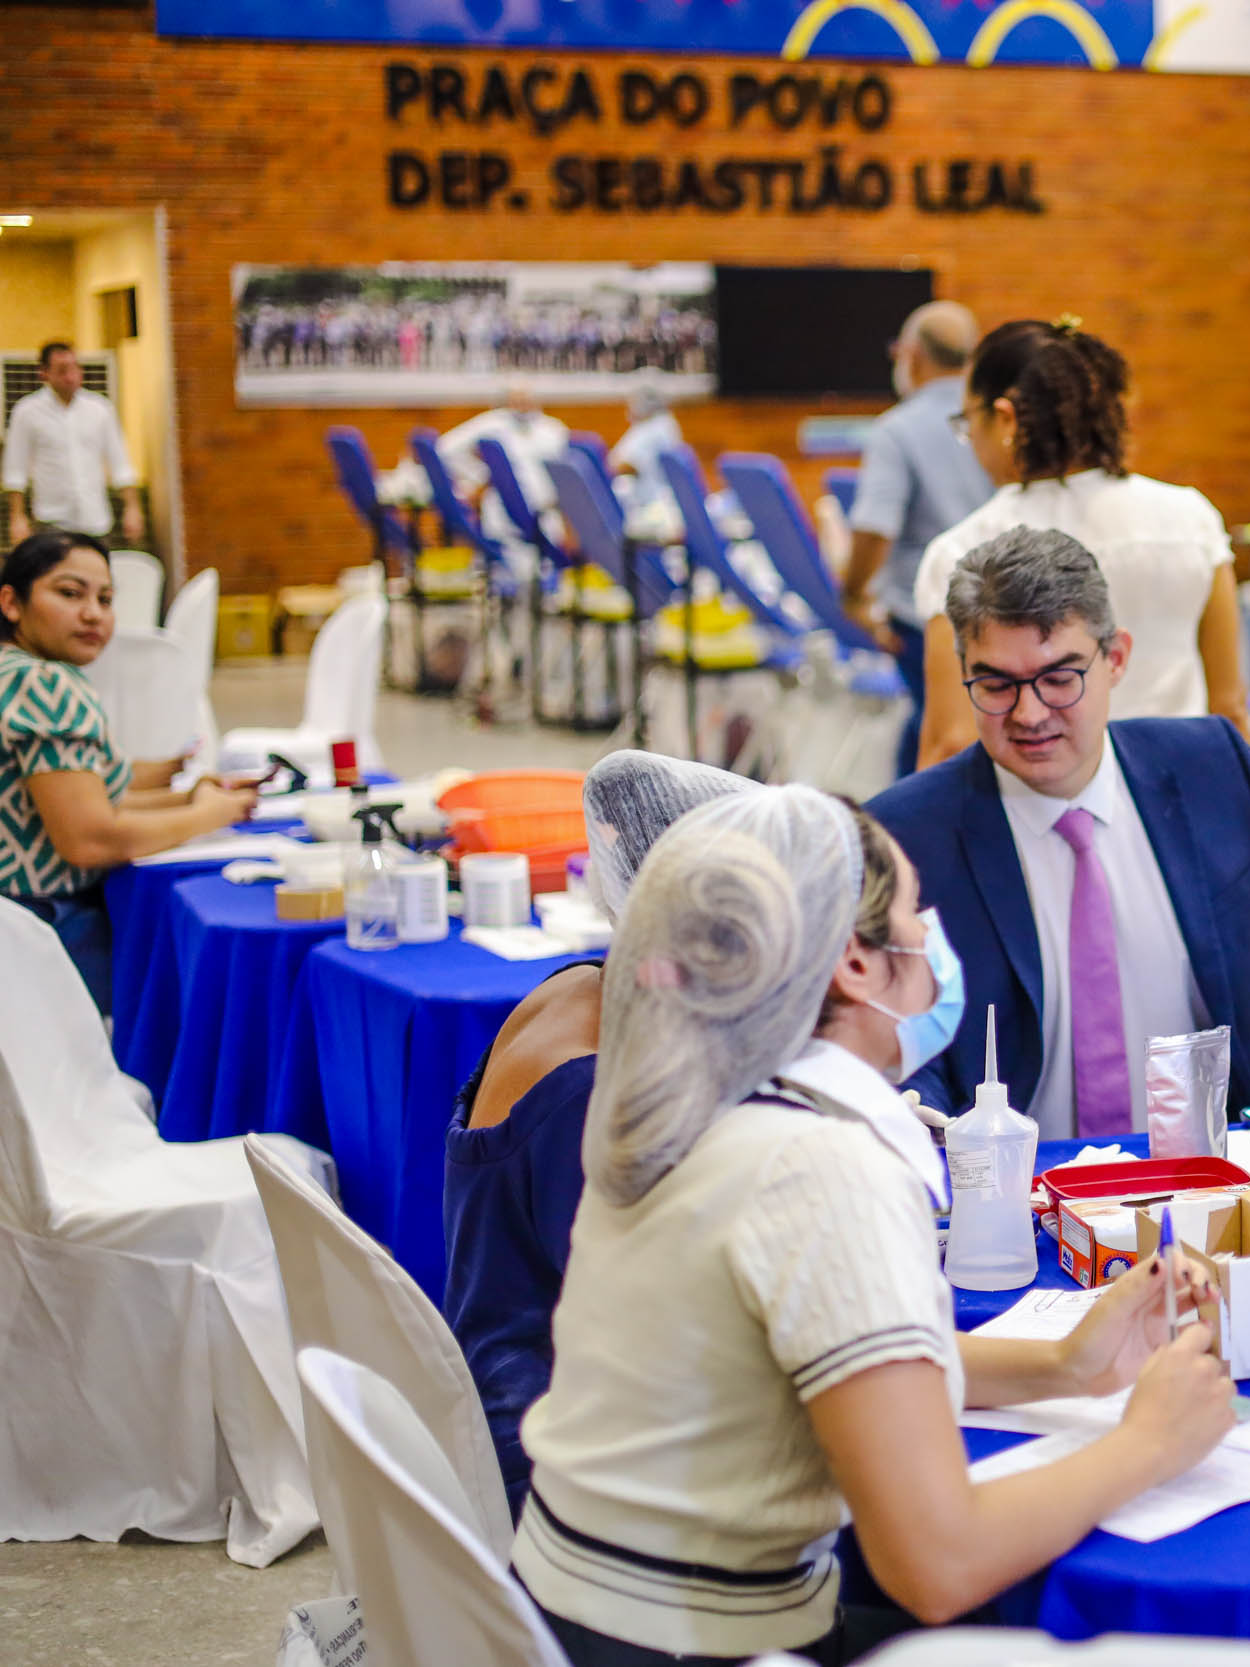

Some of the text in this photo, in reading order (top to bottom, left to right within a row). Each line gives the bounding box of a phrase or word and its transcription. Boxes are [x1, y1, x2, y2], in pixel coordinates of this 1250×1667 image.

[386, 62, 891, 138] PRAÇA DO POVO
[386, 146, 1044, 215] DEP. SEBASTIÃO LEAL
